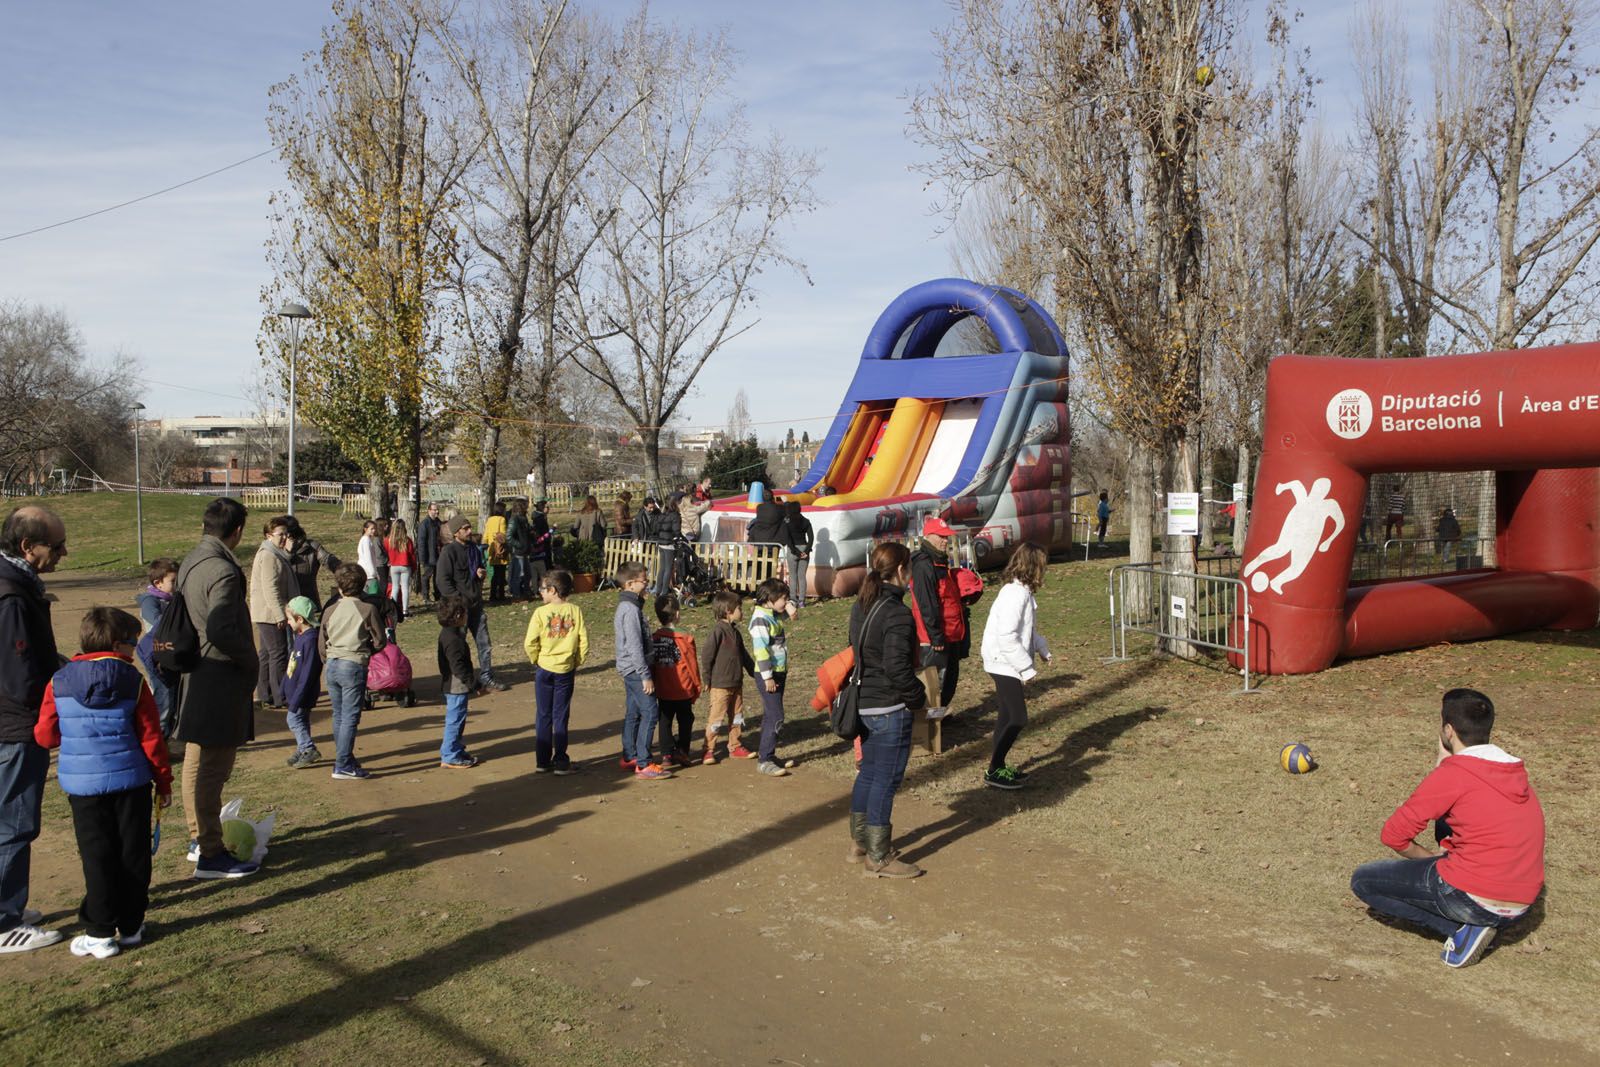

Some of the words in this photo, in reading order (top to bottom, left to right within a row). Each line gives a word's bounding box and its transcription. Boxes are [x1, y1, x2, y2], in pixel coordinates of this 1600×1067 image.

[1381, 389, 1481, 414] Diputació
[1520, 395, 1563, 413] Àrea
[1381, 413, 1482, 432] Barcelona
